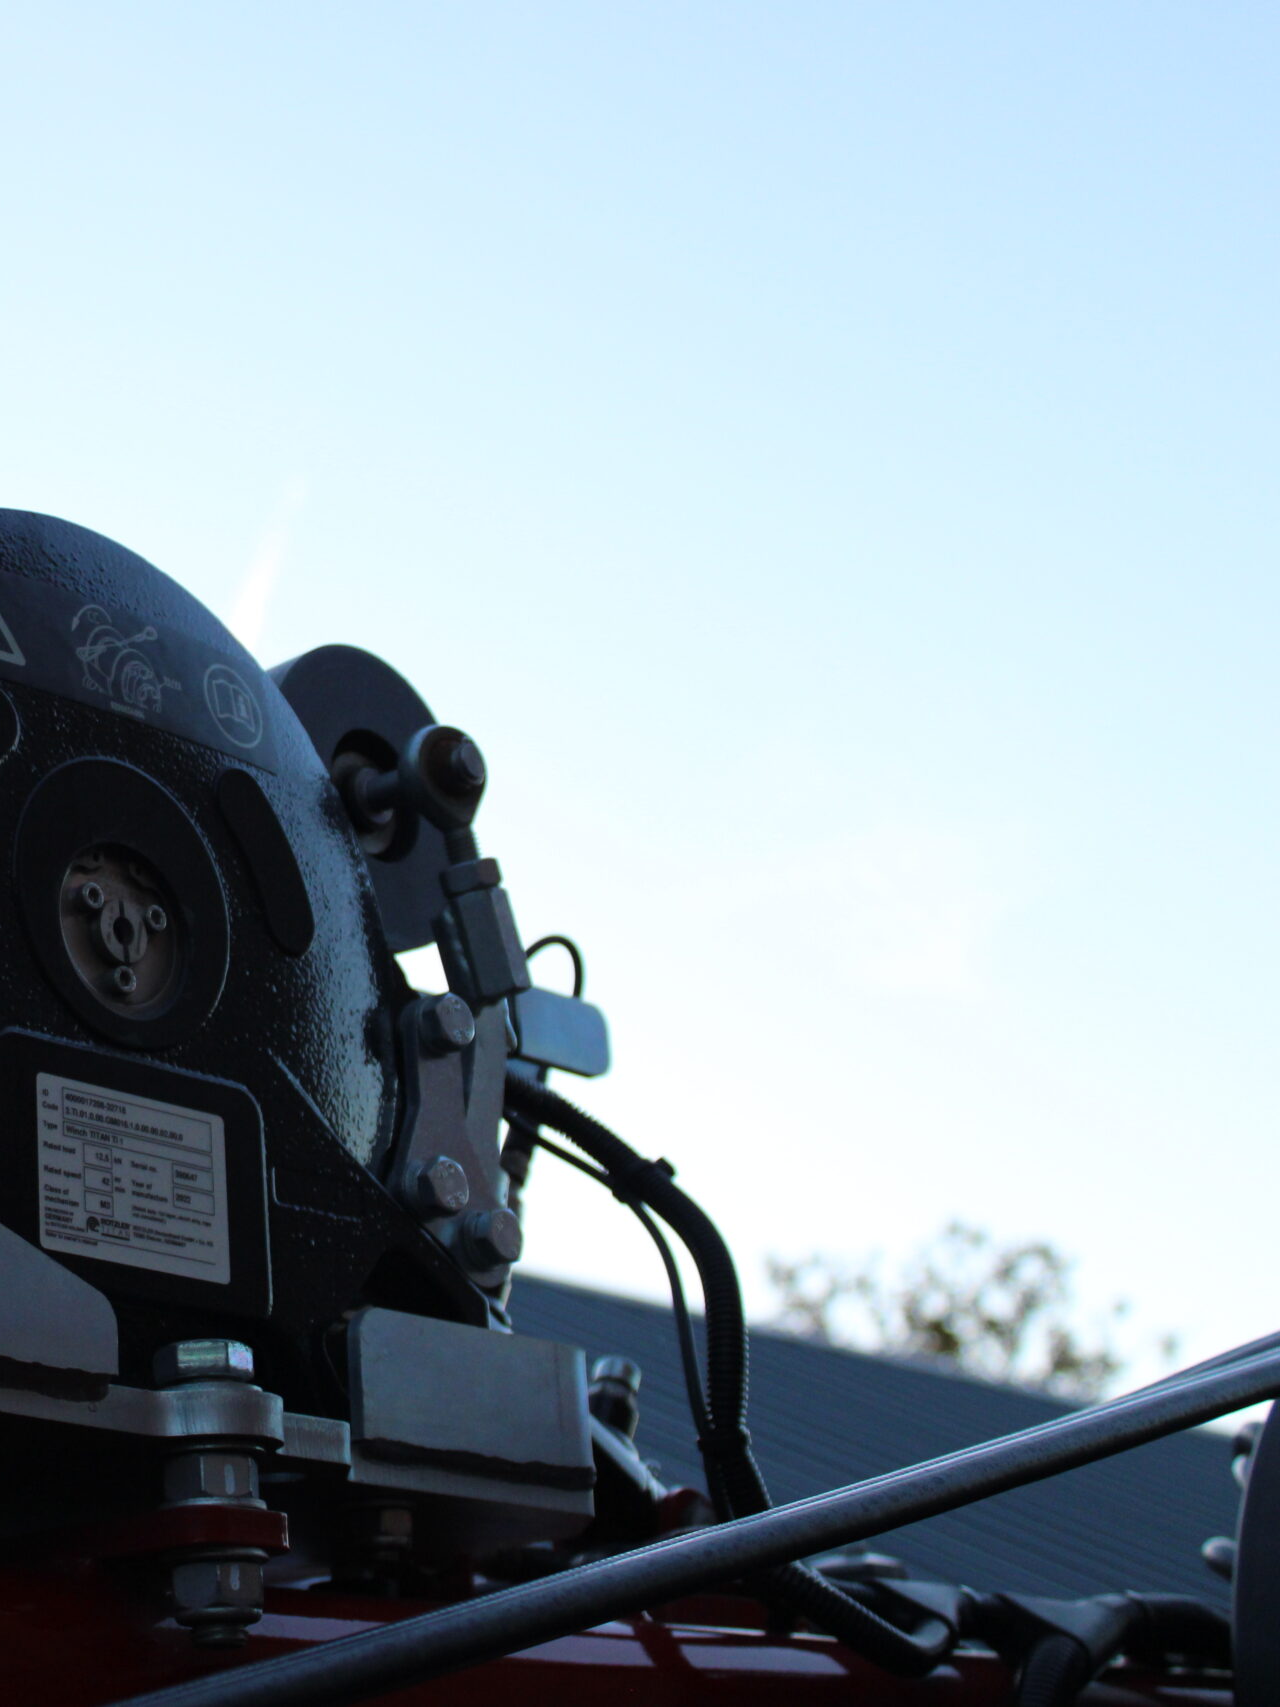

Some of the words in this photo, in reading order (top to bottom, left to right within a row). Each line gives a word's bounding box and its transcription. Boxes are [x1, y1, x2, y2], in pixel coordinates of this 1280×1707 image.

[42, 1101, 58, 1111] Code
[43, 1120, 57, 1131] Type
[67, 1126, 87, 1137] Winch
[90, 1131, 110, 1142] TITAN
[43, 1141, 61, 1151] Rated
[44, 1165, 62, 1175] Rated
[64, 1169, 81, 1180] speed
[44, 1184, 61, 1194] Class
[132, 1180, 144, 1189] Year
[45, 1195, 79, 1208] mechanism
